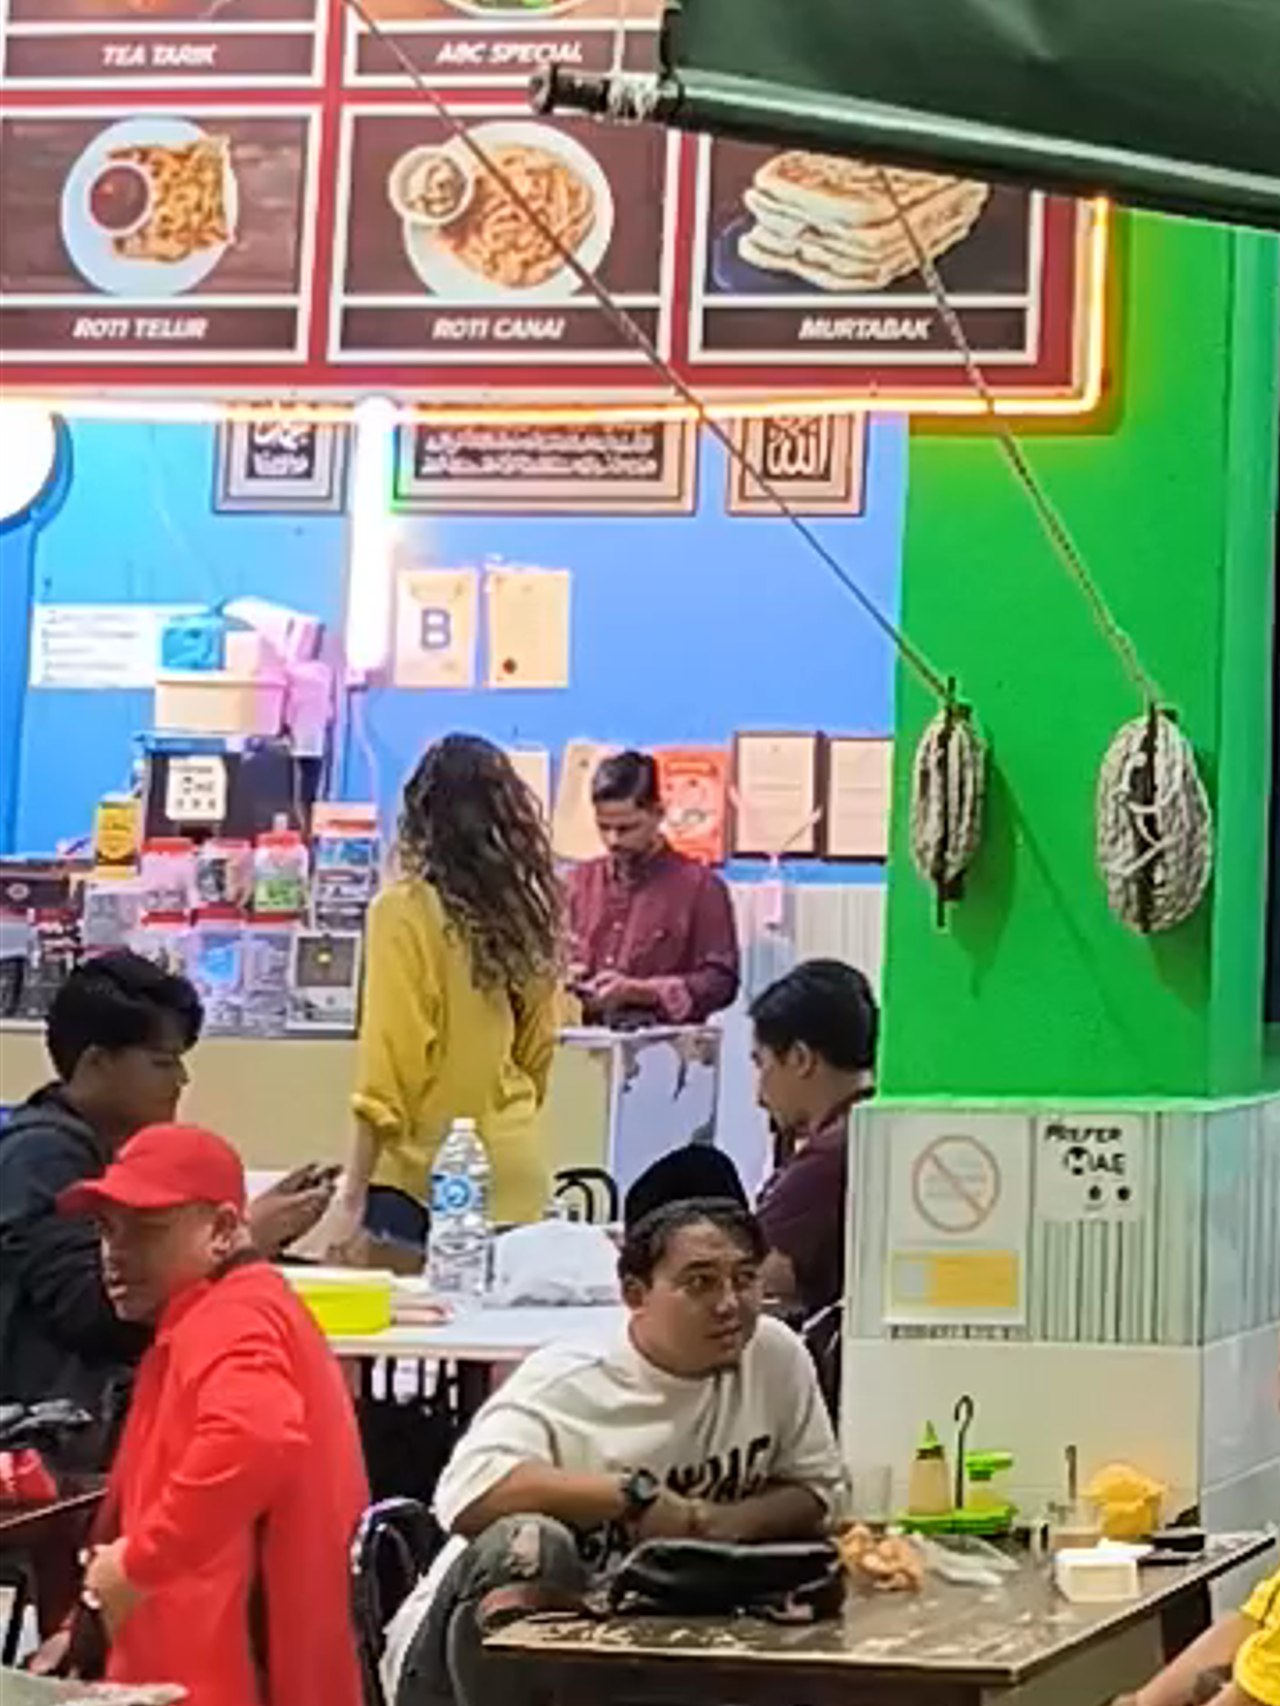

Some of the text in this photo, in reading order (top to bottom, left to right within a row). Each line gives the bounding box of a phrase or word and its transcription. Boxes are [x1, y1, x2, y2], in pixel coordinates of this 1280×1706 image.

[102, 43, 218, 67] TEA TARIK
[435, 41, 583, 65] ABC SPECIAL
[72, 317, 208, 340] ROTI TELUR
[432, 316, 565, 340] ROTI CANAI
[798, 316, 932, 341] MURTABAK
